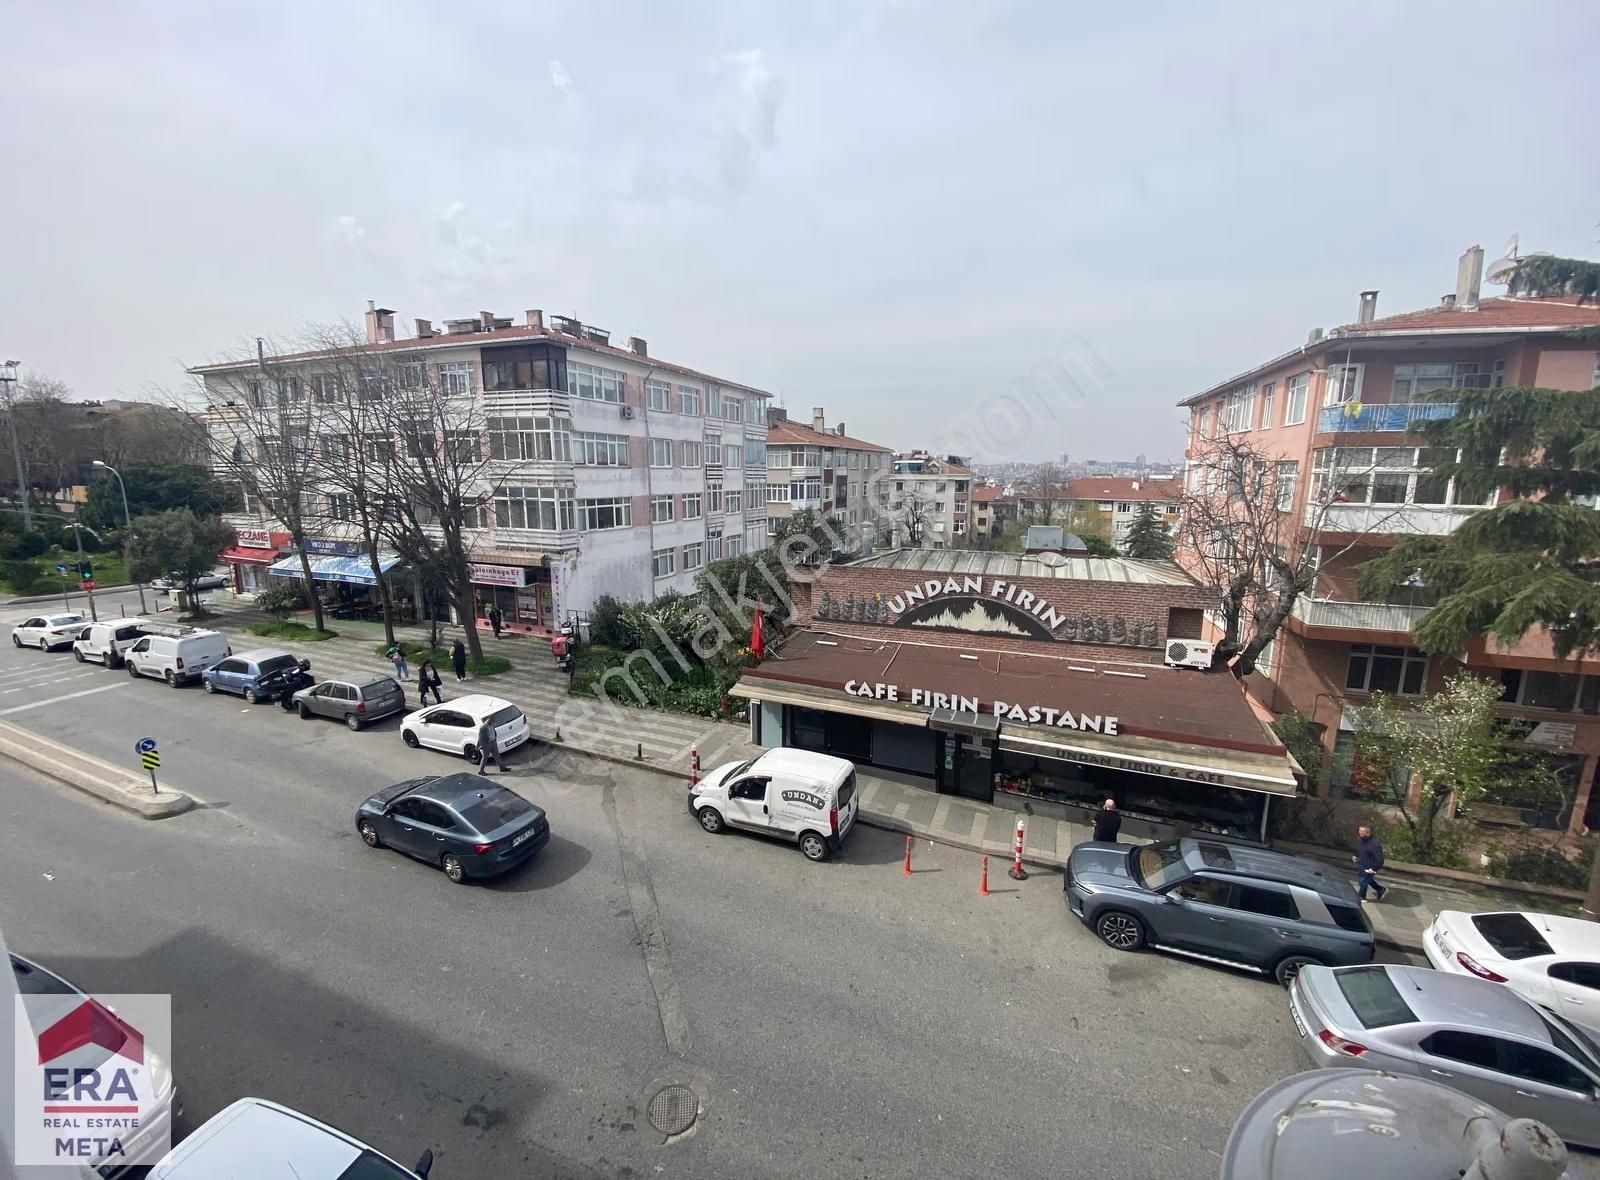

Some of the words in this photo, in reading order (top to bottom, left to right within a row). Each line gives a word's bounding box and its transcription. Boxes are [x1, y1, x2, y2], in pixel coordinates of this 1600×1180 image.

[887, 575, 983, 615] UNDAN
[991, 579, 1066, 630] FIRIN
[844, 679, 898, 702] CAFE
[911, 688, 979, 714] FIRIN
[993, 700, 1119, 736] PASTANE
[1055, 748, 1111, 767] UNDAN
[1119, 760, 1162, 775] FIRIN
[1168, 768, 1178, 778] &
[1185, 769, 1225, 785] CAFE
[787, 791, 819, 806] UNDAN
